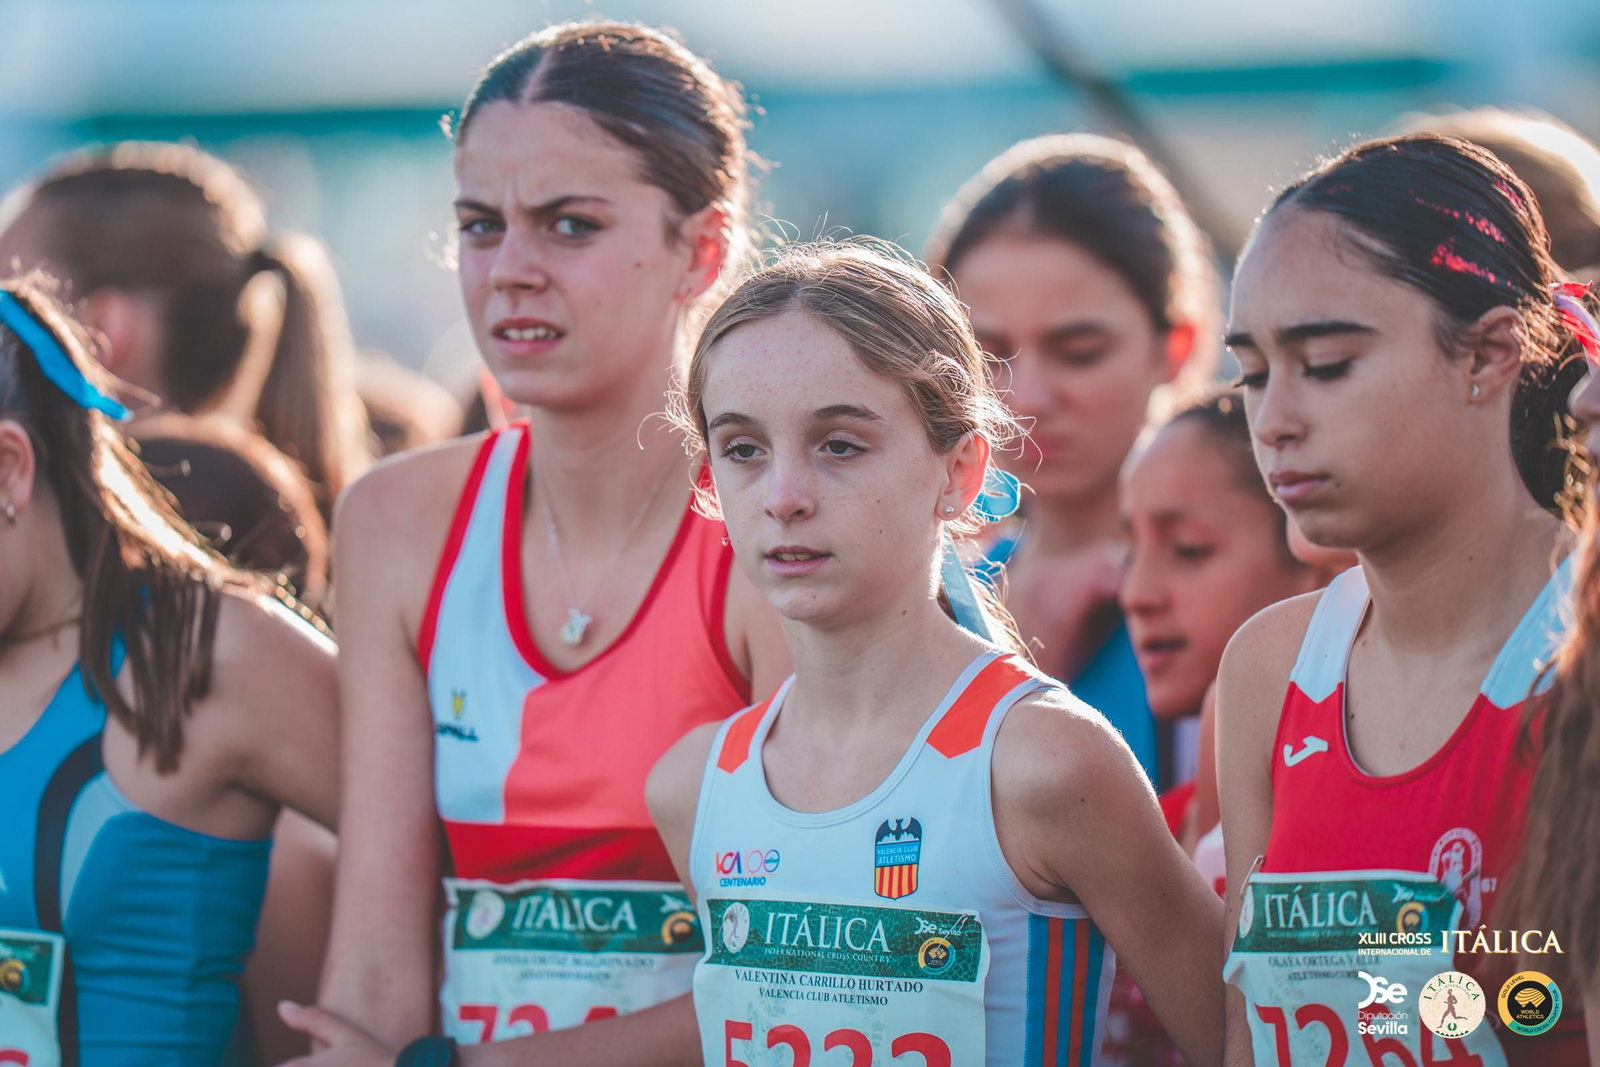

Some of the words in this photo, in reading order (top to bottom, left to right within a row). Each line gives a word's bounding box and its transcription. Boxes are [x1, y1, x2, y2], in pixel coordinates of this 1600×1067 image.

[877, 847, 902, 855] VALENCIA
[878, 854, 916, 864] ATLETISMO
[719, 876, 766, 887] CENTENARIO
[1264, 884, 1378, 929] ITÁLICA
[764, 905, 892, 953] ITÁLICA
[764, 947, 824, 959] INTERNATIONAL
[827, 951, 850, 960] CROSS
[852, 953, 892, 963] COUNTRY
[735, 969, 796, 985] VALENTINA
[799, 974, 856, 990] CARRILLO
[859, 978, 924, 993] HURTADO
[759, 987, 804, 1000] VALENCIA
[806, 991, 830, 1002] CLUB
[831, 994, 888, 1006] ATLETISMO
